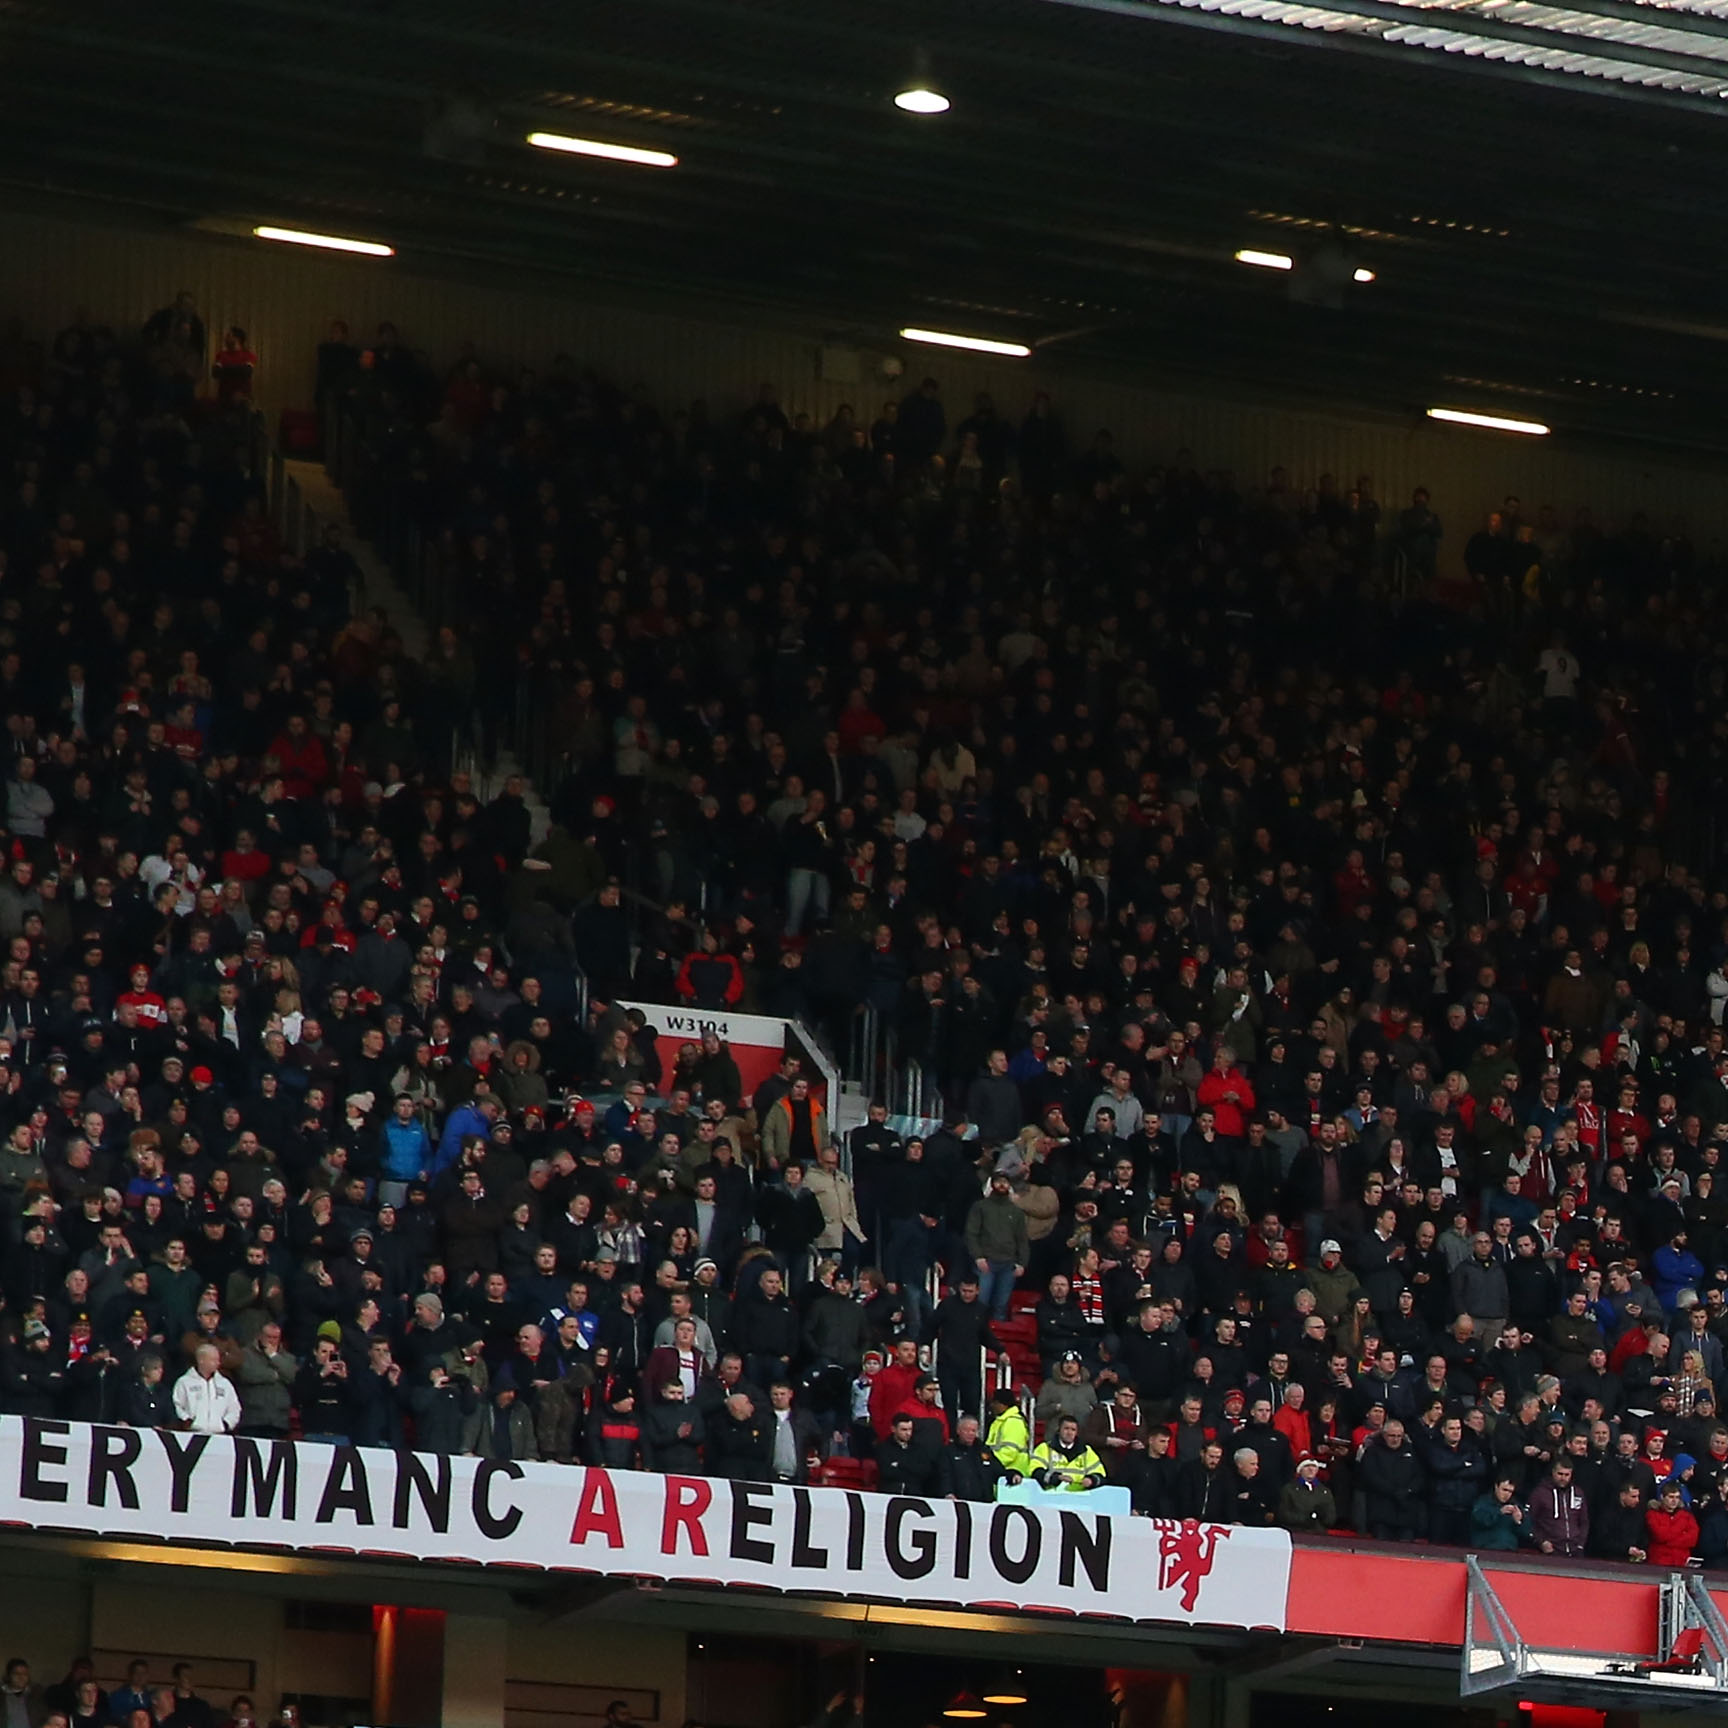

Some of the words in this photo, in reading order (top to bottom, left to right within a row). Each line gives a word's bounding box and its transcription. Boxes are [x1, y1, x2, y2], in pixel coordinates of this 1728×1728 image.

[666, 1016, 729, 1035] W3104
[570, 1466, 624, 1549] A
[660, 1474, 1112, 1593] RELIGION
